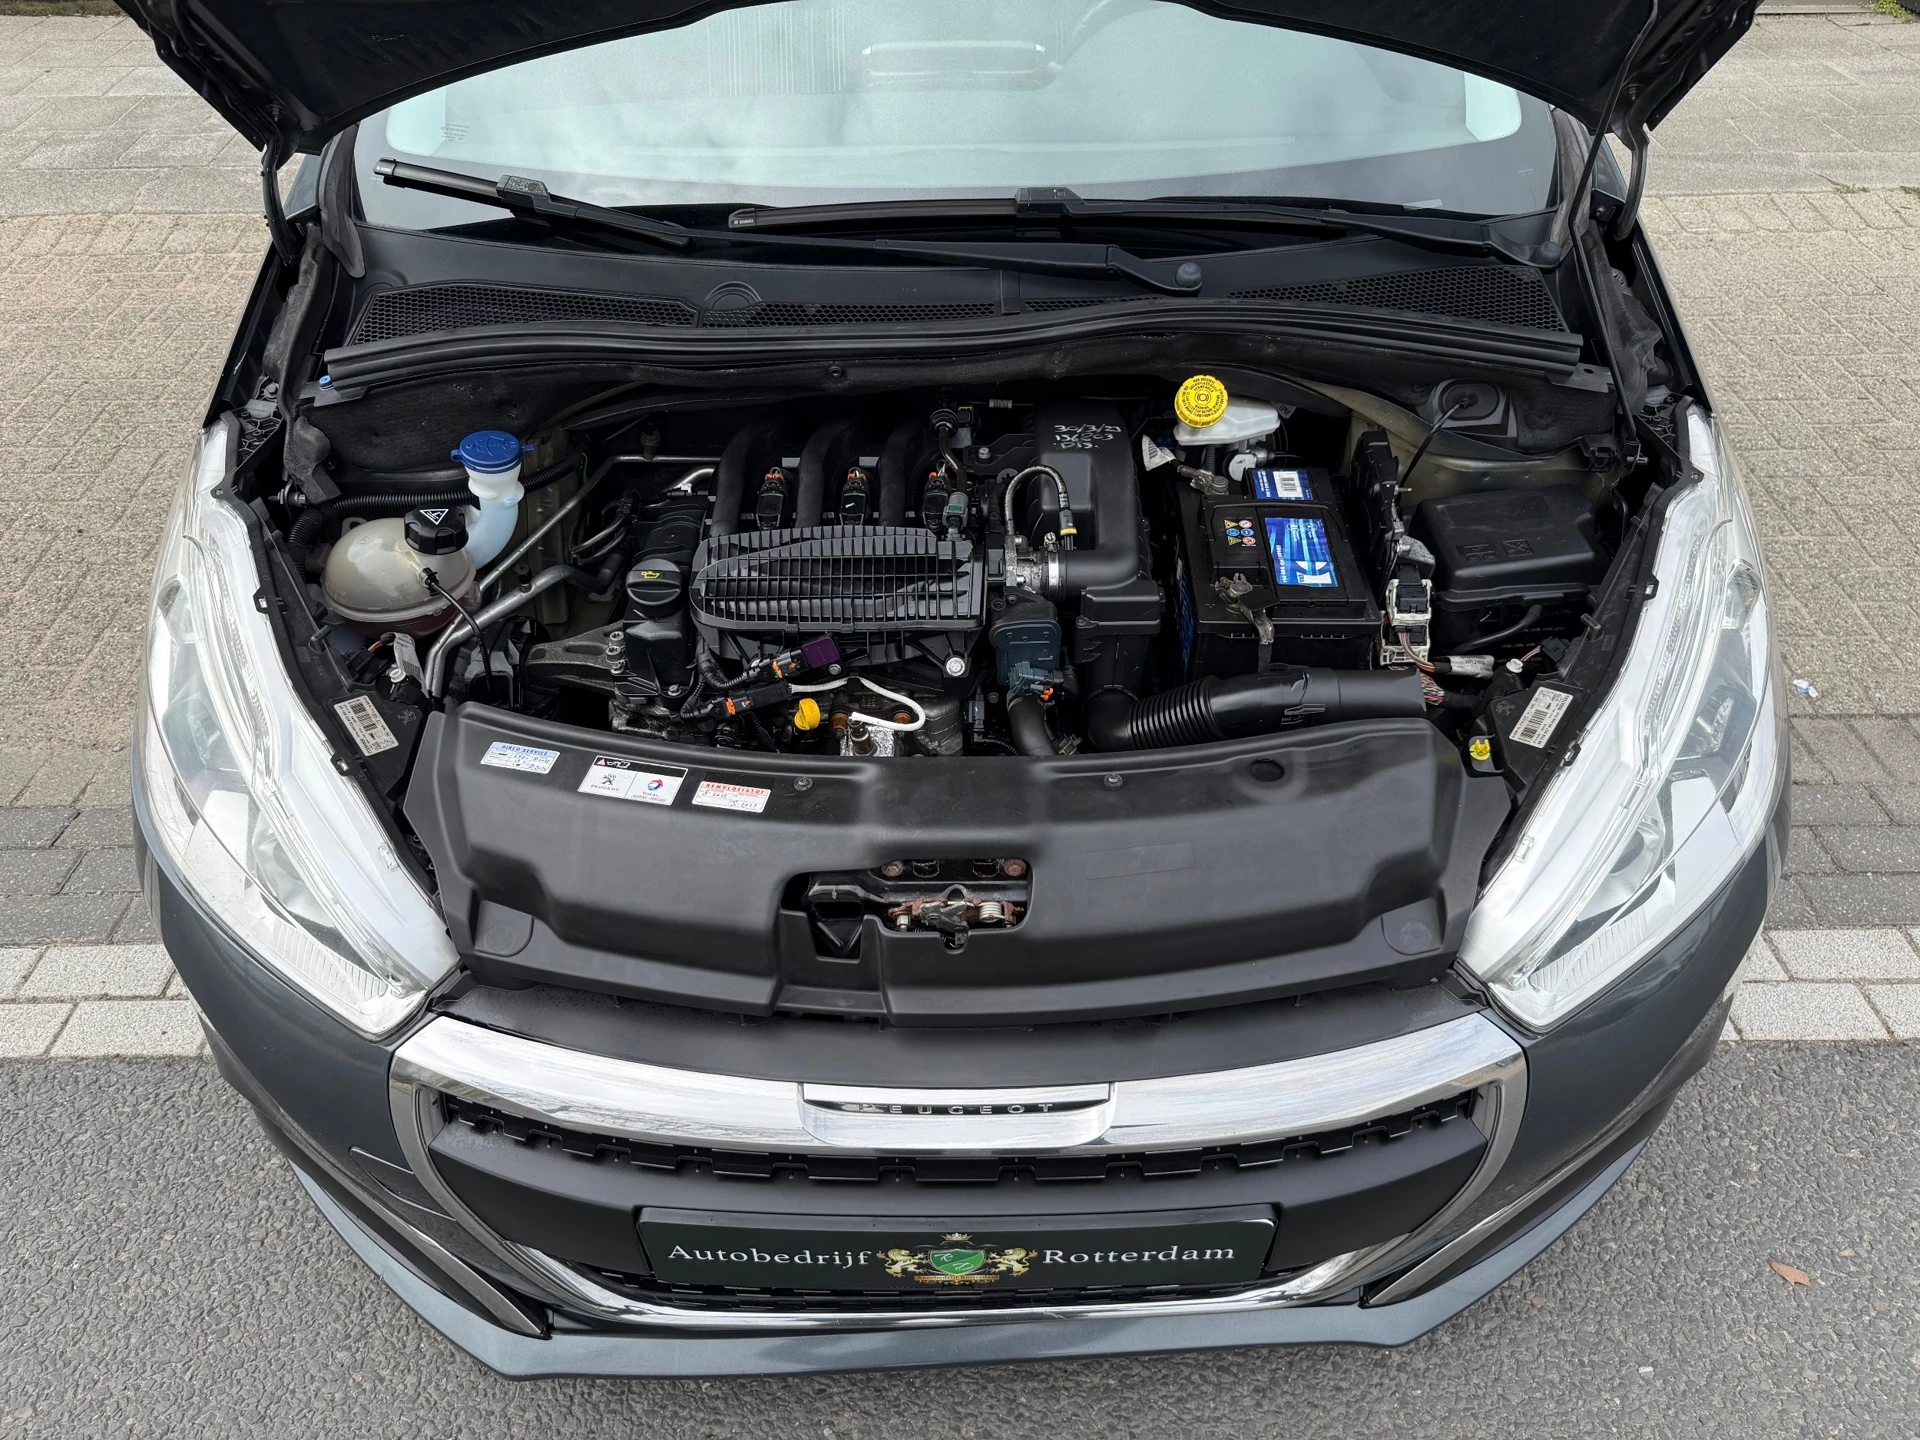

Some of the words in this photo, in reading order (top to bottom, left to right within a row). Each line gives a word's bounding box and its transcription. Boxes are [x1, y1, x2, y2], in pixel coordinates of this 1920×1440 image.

[522, 748, 549, 756] SERVICE
[857, 1103, 1053, 1114] PEUGEOT
[667, 1245, 873, 1266] Autobedrijf
[1043, 1244, 1236, 1264] Rotterdam
